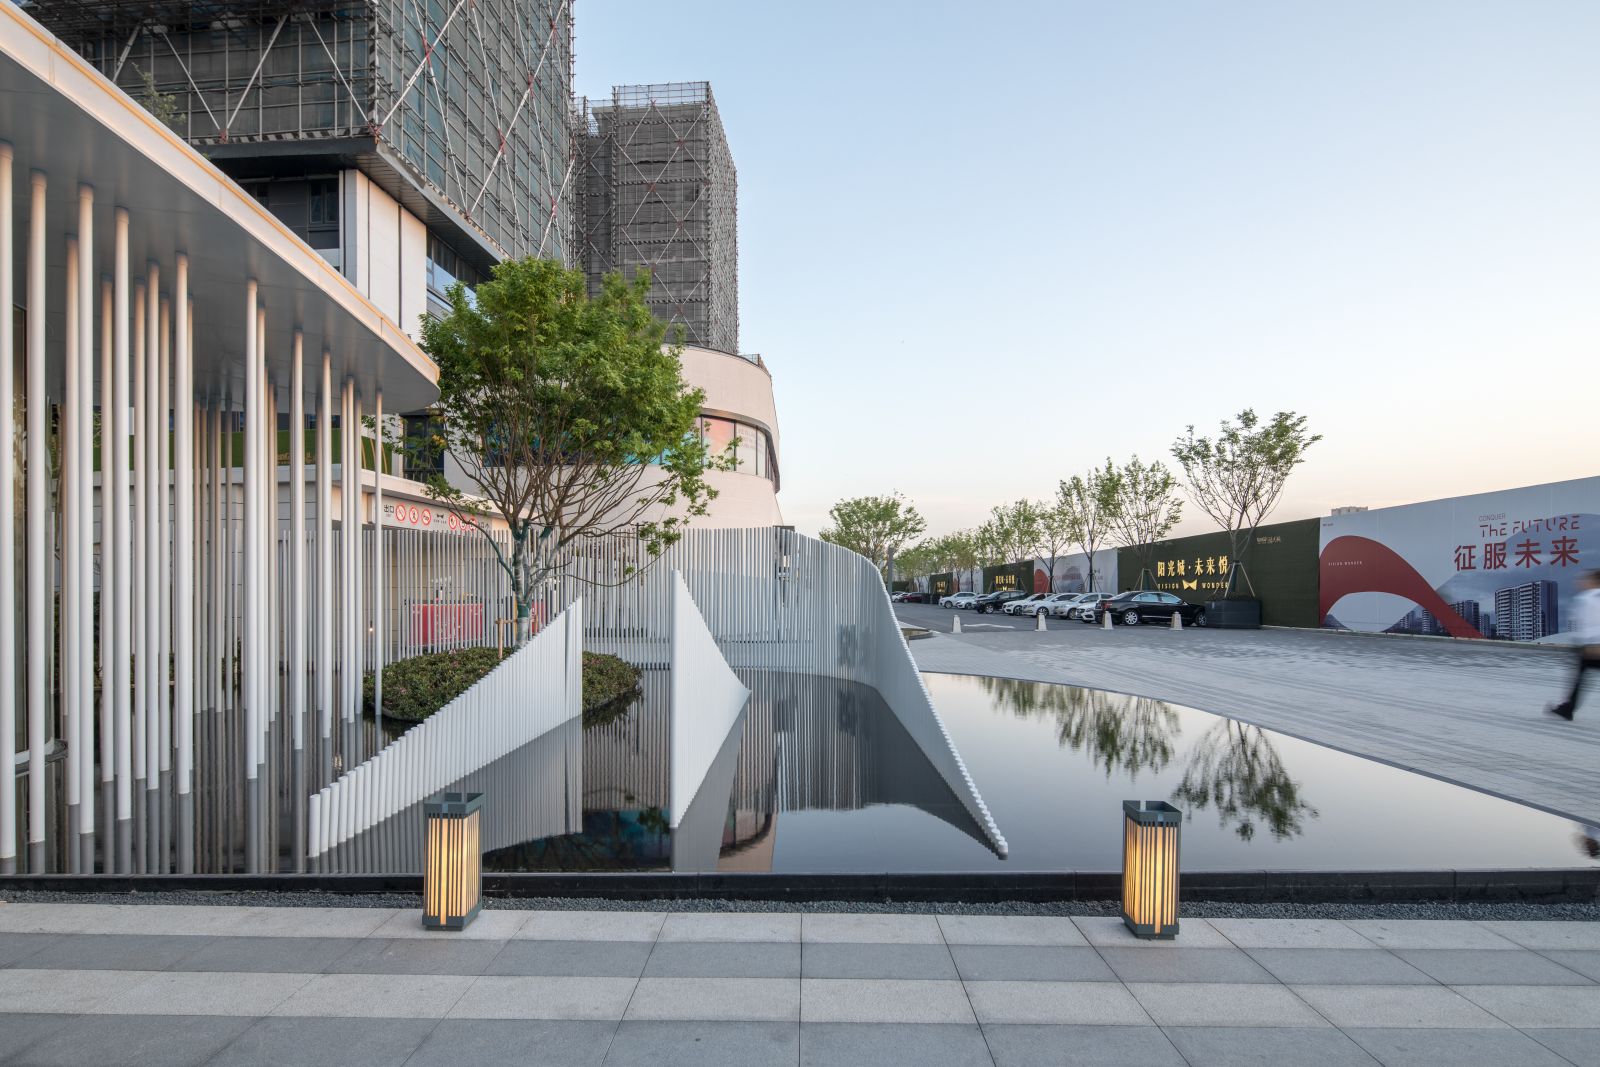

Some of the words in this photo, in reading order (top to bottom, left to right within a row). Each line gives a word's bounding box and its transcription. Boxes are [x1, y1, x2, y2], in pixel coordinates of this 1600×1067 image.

[1478, 513, 1506, 522] CONQUER
[1512, 515, 1580, 534] FUTURE
[1454, 535, 1580, 571] 征服未来
